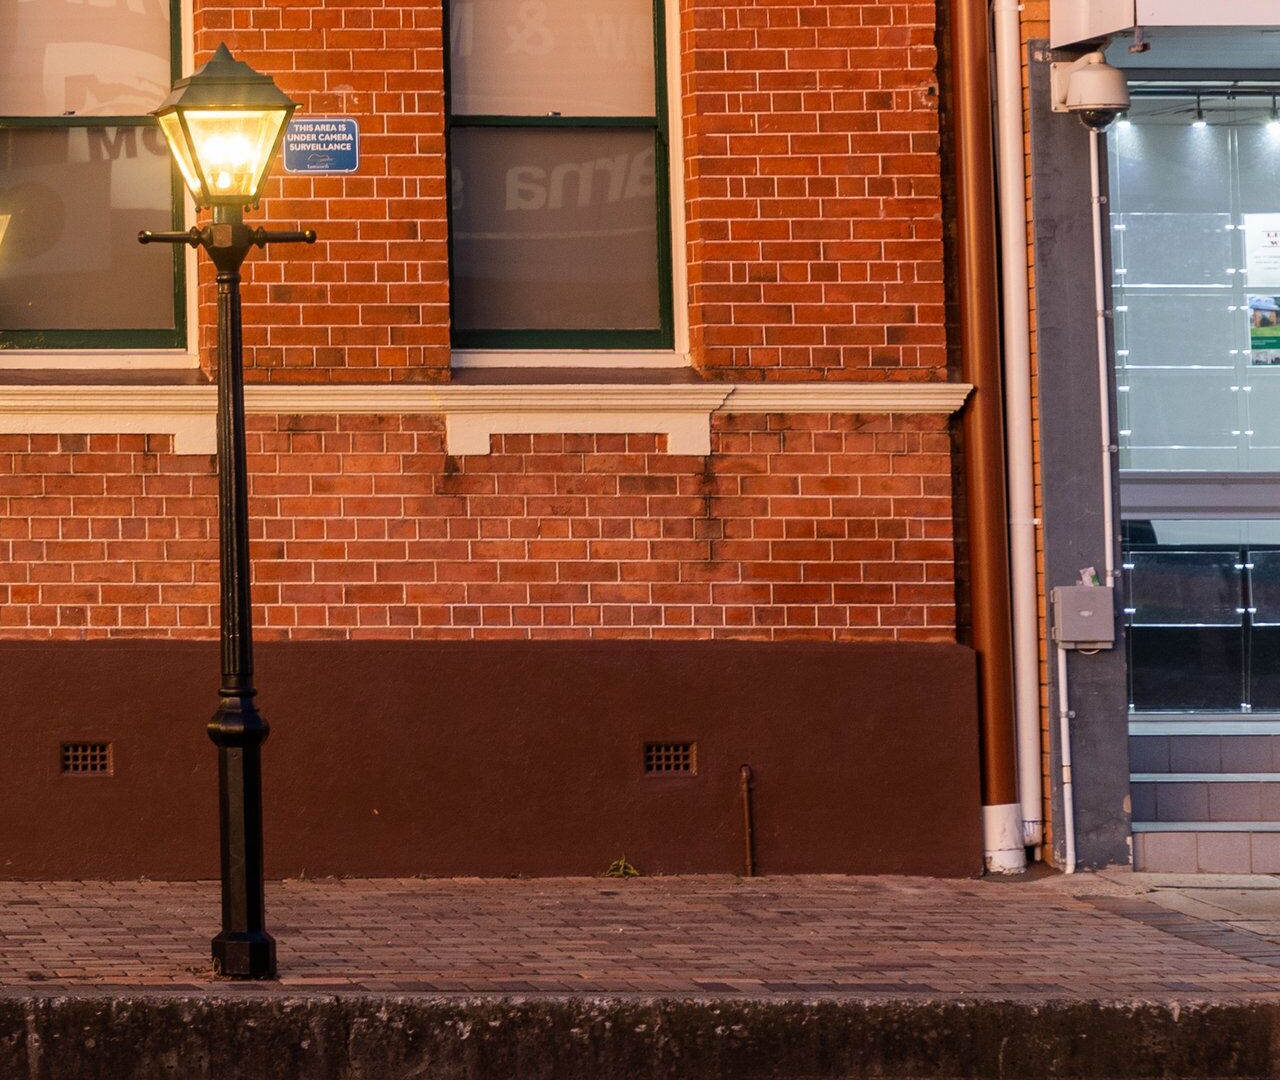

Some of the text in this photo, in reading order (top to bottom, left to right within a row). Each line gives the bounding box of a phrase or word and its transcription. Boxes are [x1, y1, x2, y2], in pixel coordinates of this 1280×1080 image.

[294, 124, 347, 132] THIS AREA IS
[287, 133, 354, 141] UNDER CAMERA
[289, 142, 352, 151] SURVEILLANCE
